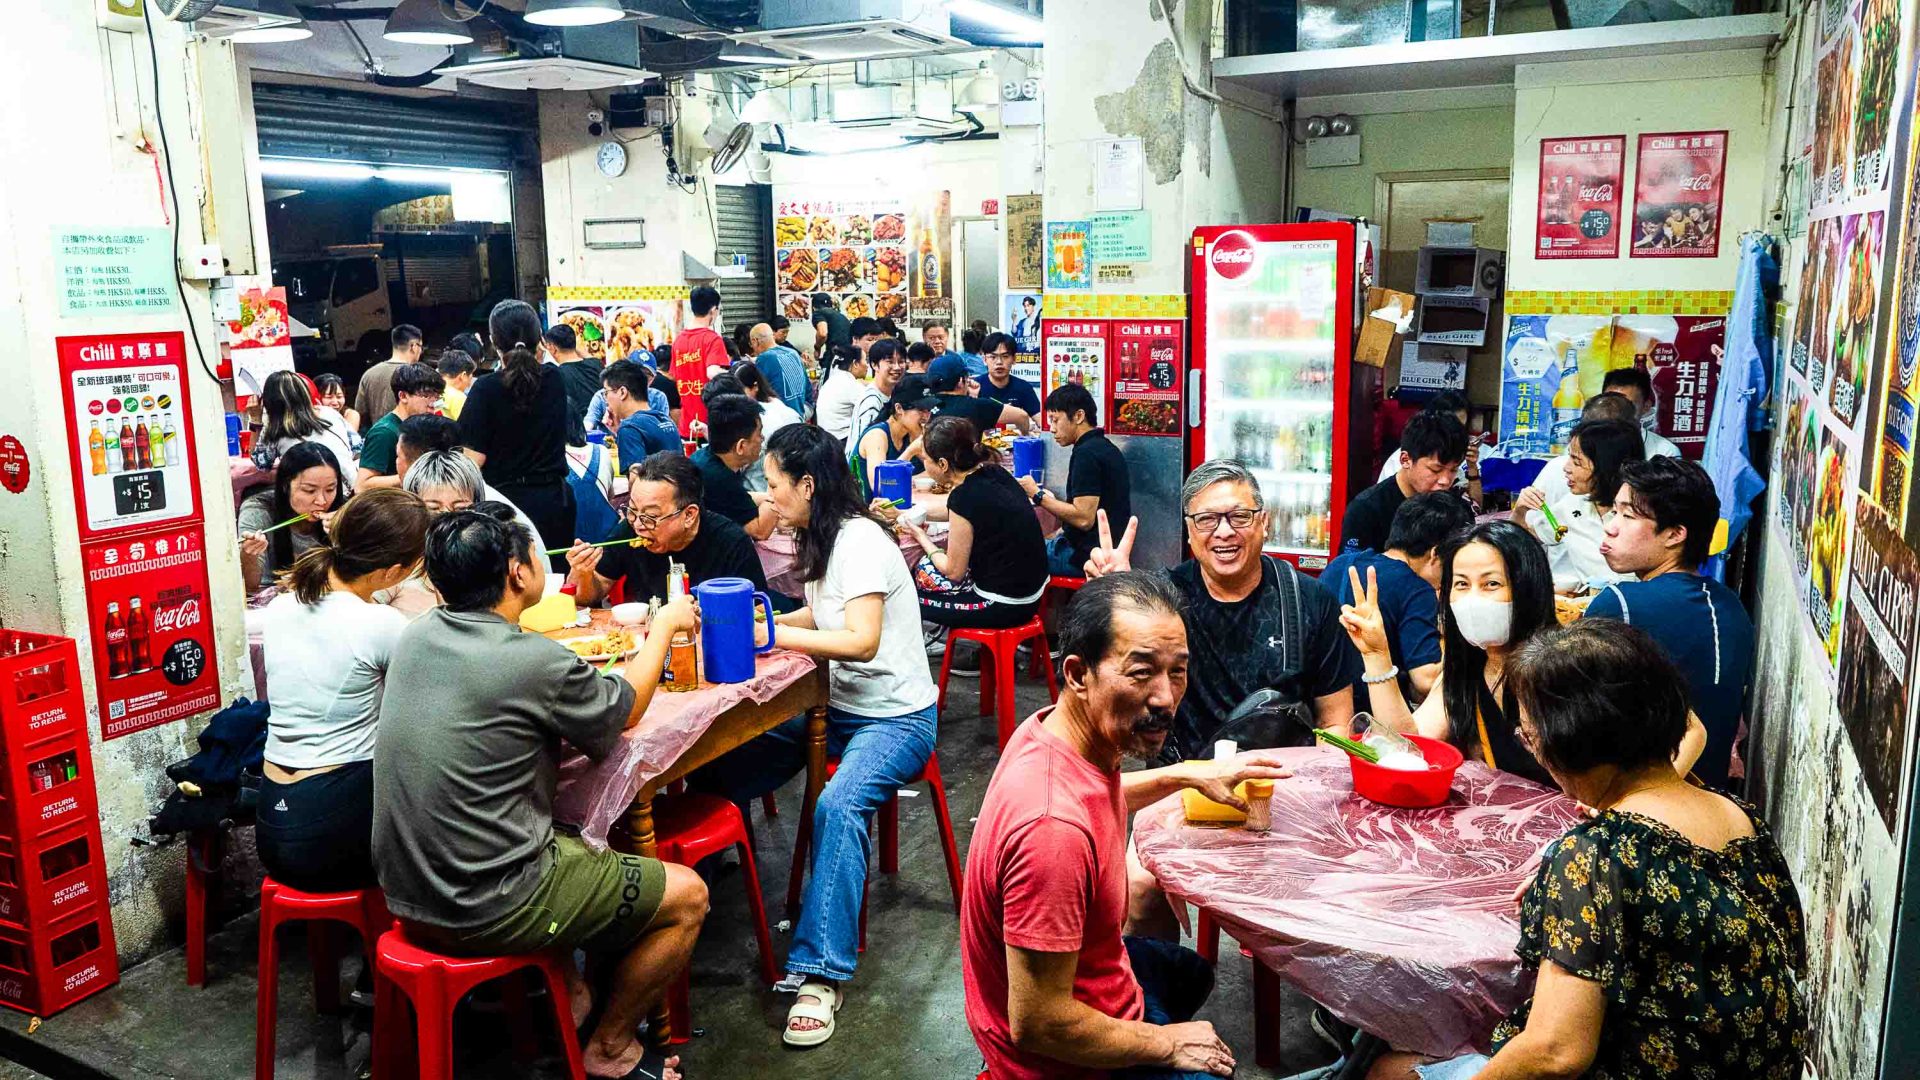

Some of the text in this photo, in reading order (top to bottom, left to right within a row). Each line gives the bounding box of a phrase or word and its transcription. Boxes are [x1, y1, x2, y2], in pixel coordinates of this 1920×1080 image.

[1553, 142, 1576, 154] Chill
[1652, 138, 1676, 149] Chill
[1052, 323, 1071, 334] Chill
[1121, 325, 1141, 336] Chill
[80, 342, 116, 362] Chill
[1513, 357, 1519, 367] $
[1673, 361, 1696, 432] 生力啤酒
[138, 482, 152, 500] 15
[1853, 527, 1880, 600] BLUE
[154, 599, 201, 633] Coca-Cola
[29, 713, 67, 730] TO REUSE
[31, 707, 63, 723] RETURN
[41, 802, 79, 820] TO REUSE
[43, 797, 75, 813] RETURN
[52, 885, 90, 906] TO REUSE
[54, 881, 86, 899] RETURN
[64, 969, 100, 992] TO REUSE
[65, 964, 97, 985] RETURN
